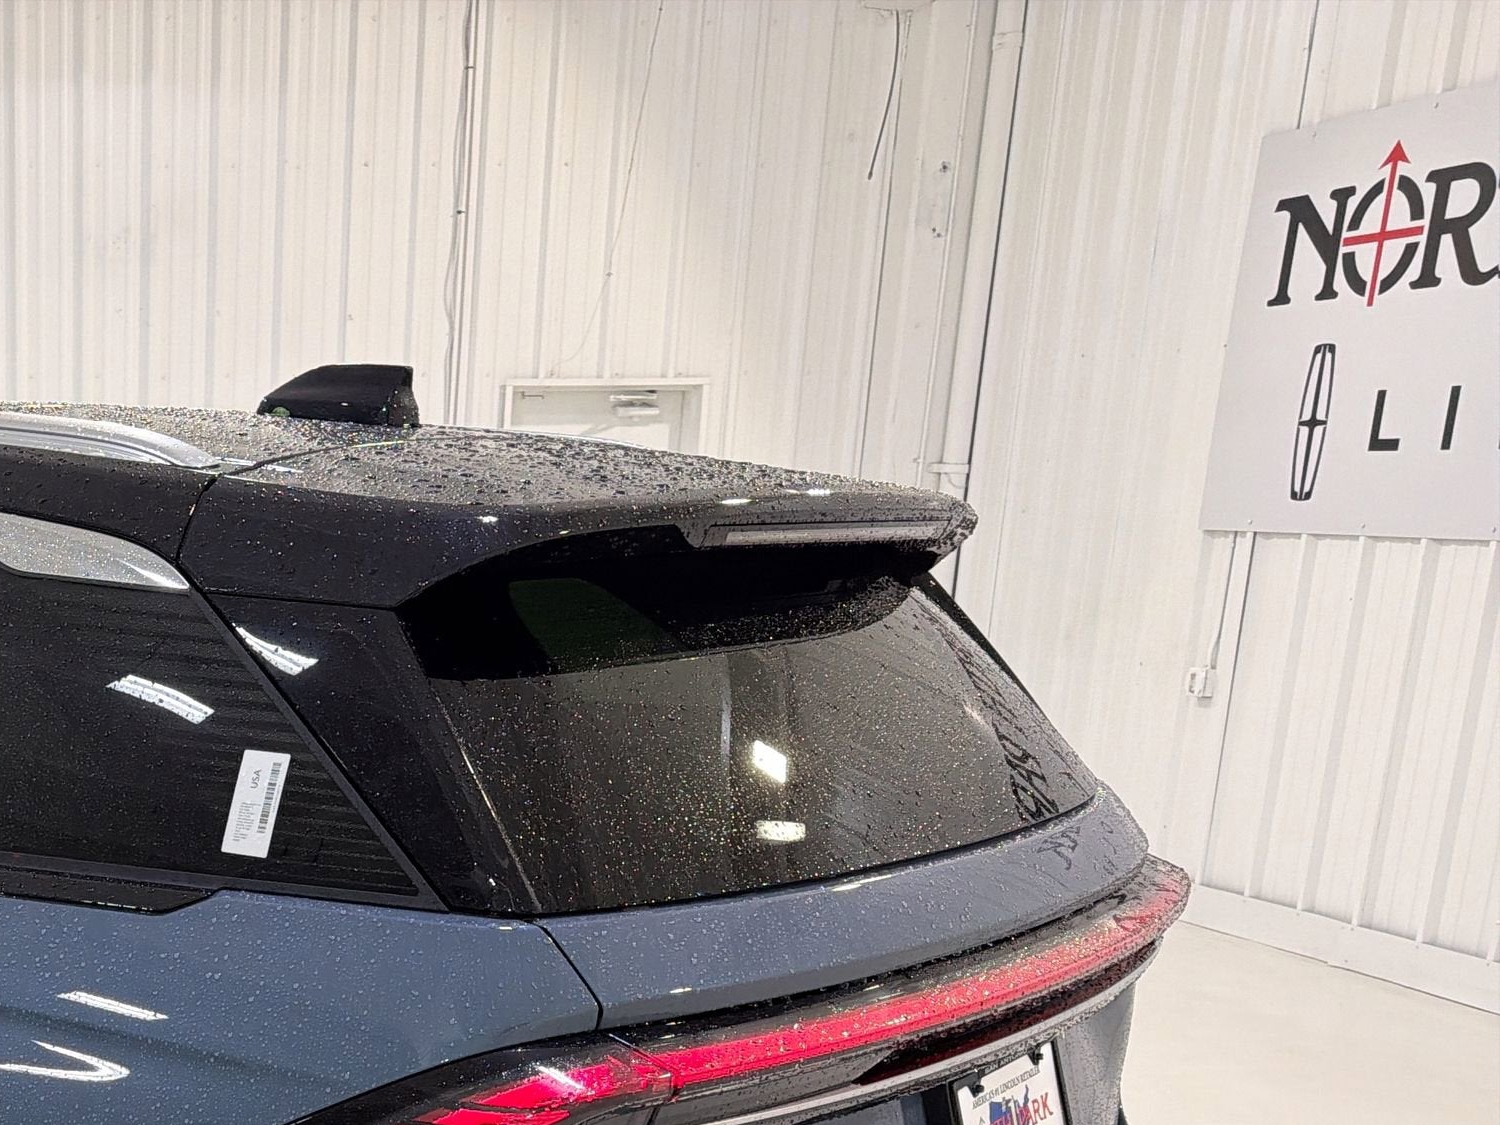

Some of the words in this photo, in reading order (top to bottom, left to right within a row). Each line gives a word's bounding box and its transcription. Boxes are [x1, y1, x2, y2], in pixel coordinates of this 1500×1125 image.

[1266, 161, 1500, 307] NOR
[1367, 384, 1500, 451] LI
[250, 769, 262, 789] USA
